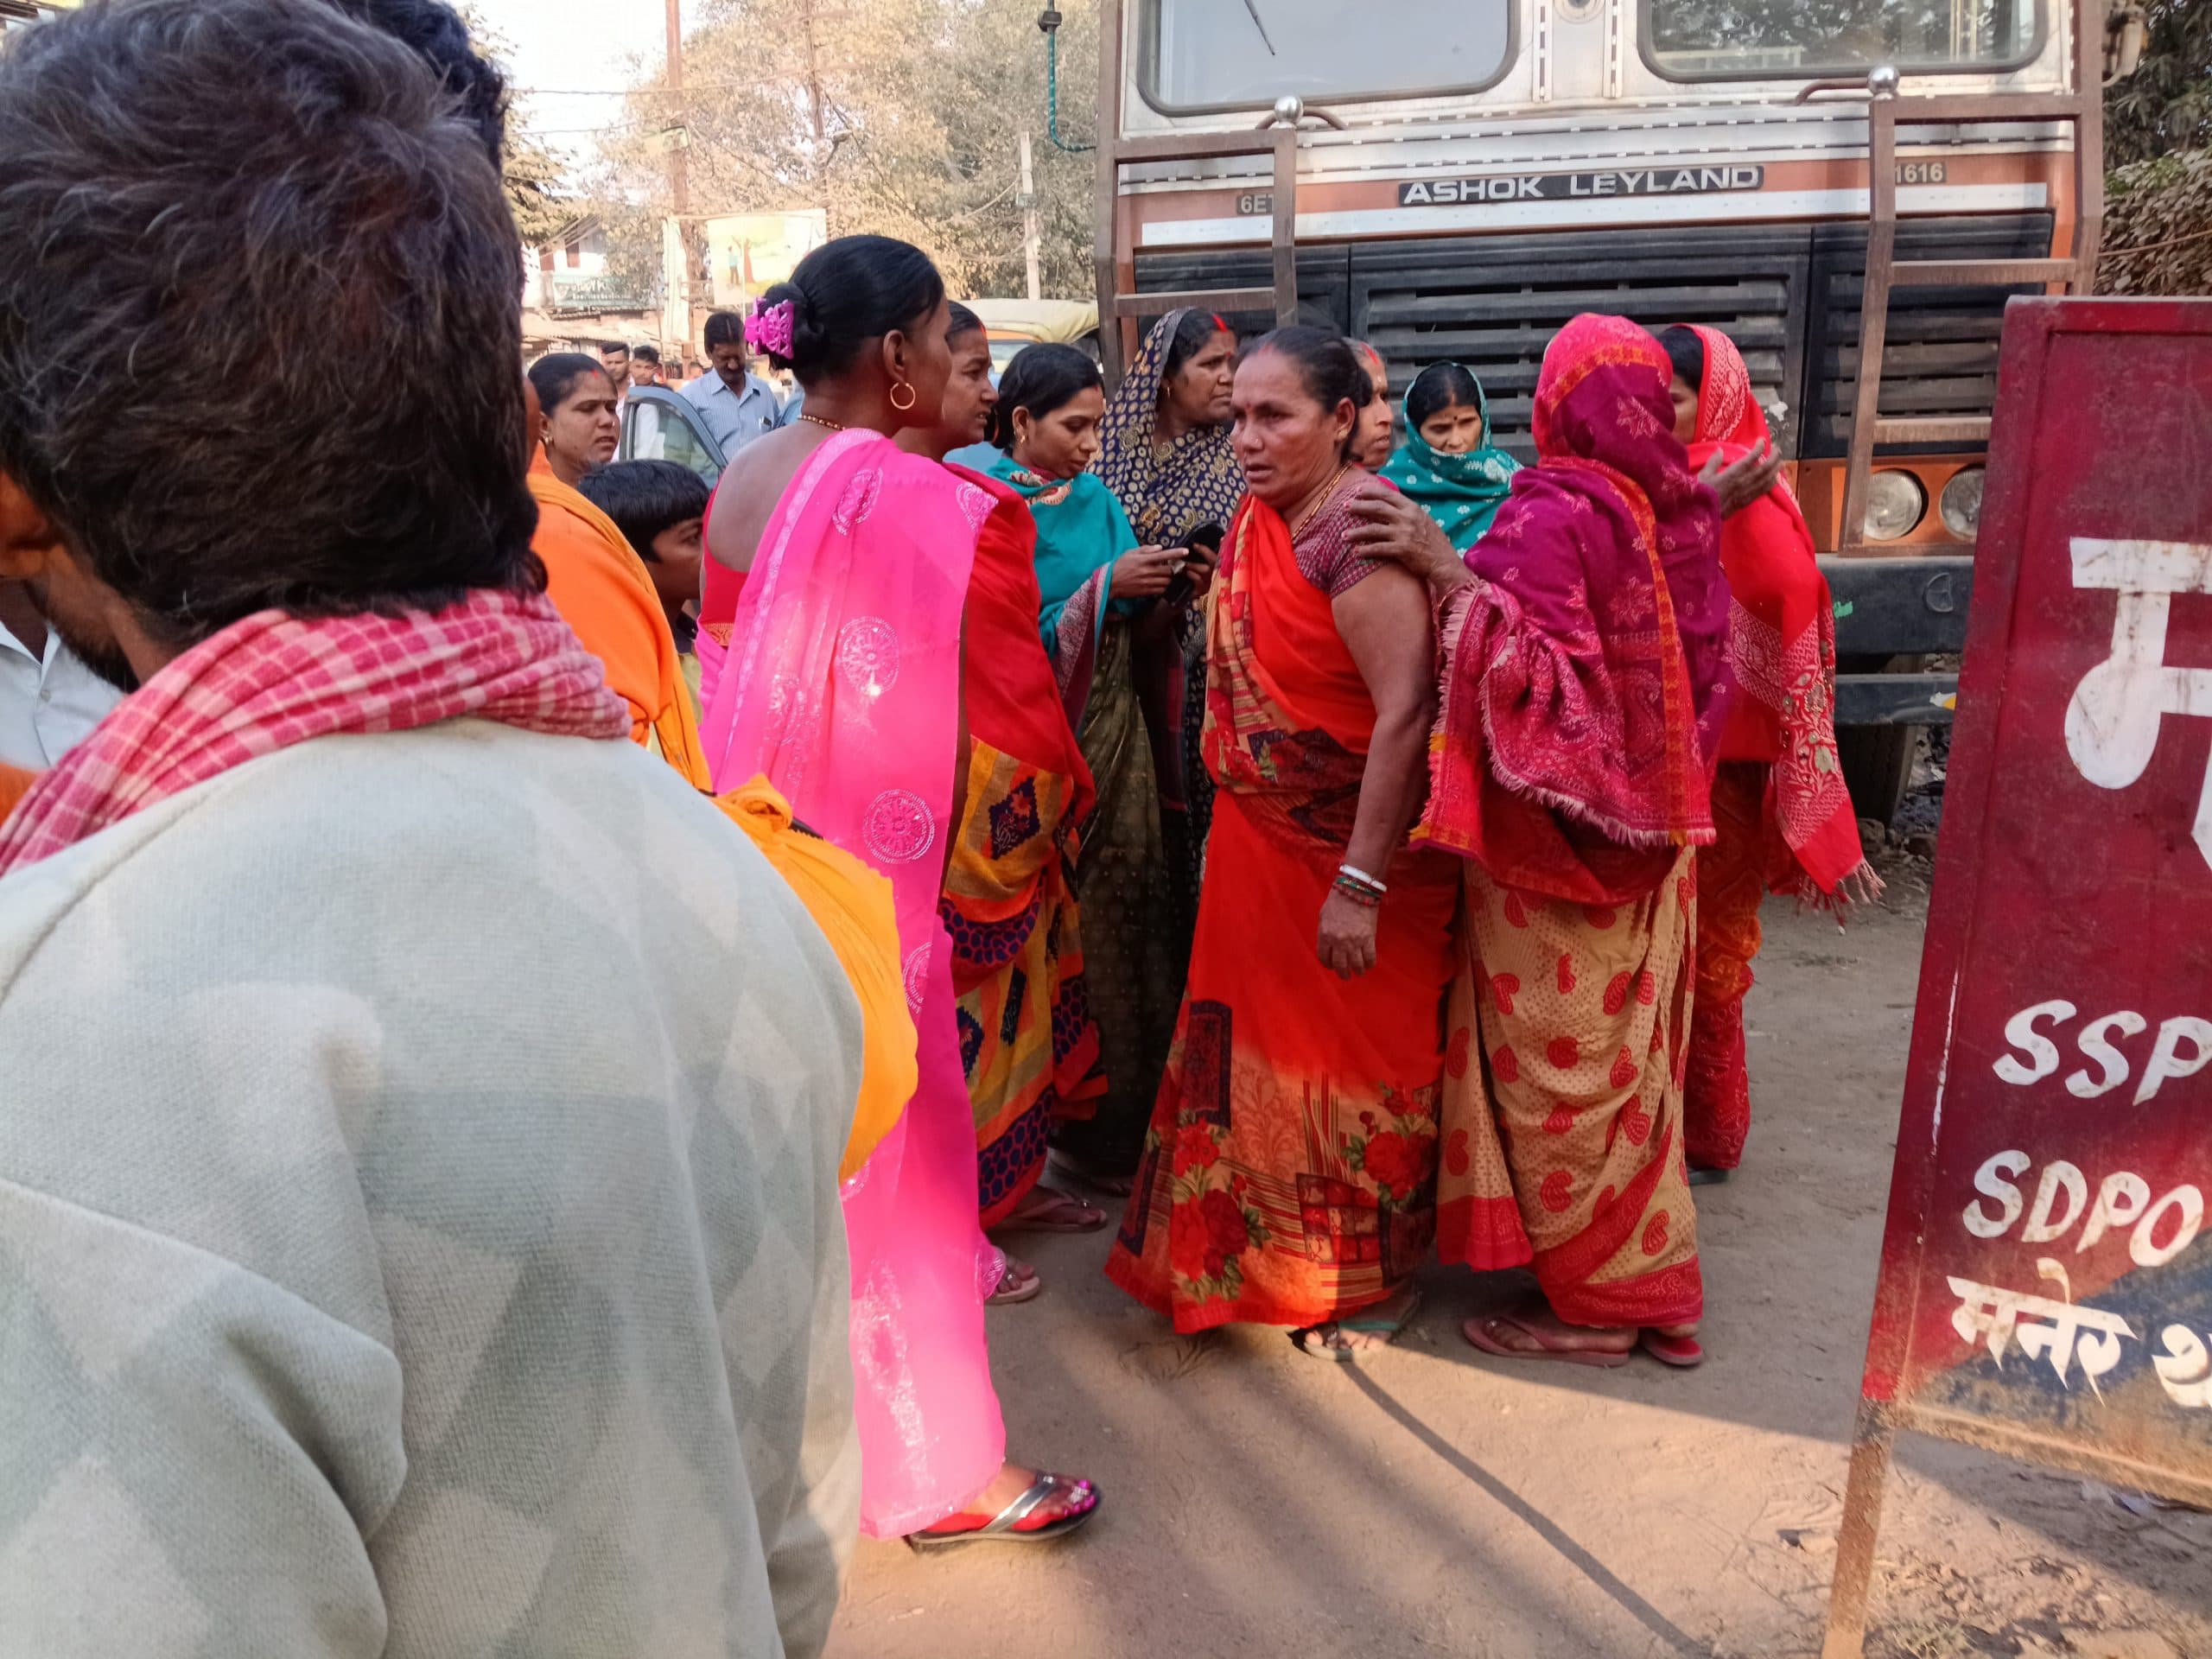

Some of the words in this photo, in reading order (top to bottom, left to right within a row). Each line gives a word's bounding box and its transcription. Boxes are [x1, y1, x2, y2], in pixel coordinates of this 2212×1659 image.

[1402, 175, 1545, 204] ASHOK
[1569, 165, 1760, 195] LEYLAND
[1894, 162, 1943, 183] 1616
[1993, 999, 2212, 1106] SSP
[1962, 1149, 2204, 1267] SDPO
[1947, 1257, 2140, 1408] मनेर
